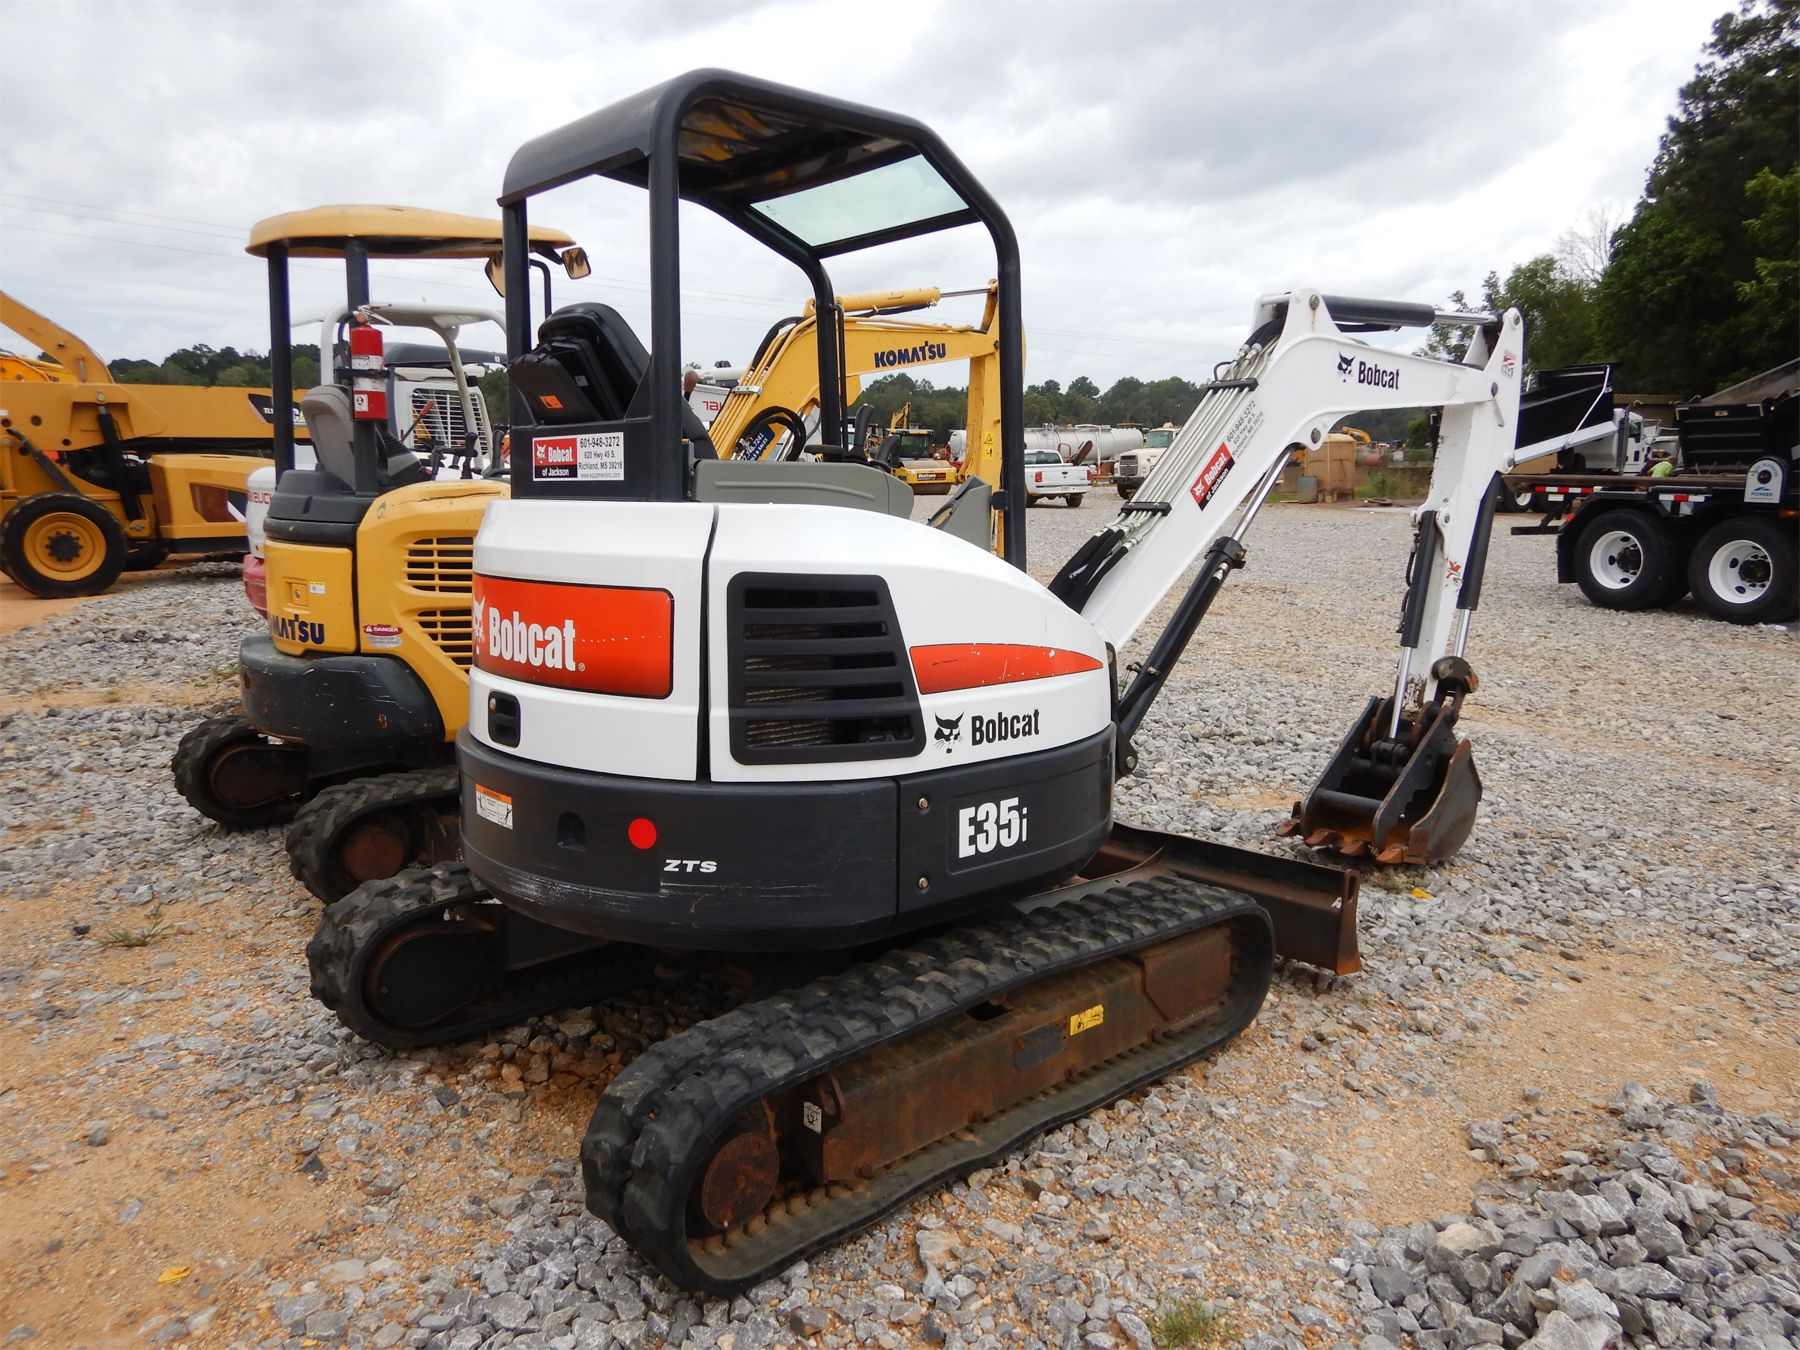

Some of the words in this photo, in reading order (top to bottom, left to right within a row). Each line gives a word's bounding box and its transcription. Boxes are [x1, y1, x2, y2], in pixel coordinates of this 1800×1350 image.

[874, 341, 946, 368] KOMATSU
[1358, 361, 1399, 390] Bobcat
[547, 446, 573, 463] Bobcat
[580, 436, 620, 448] 601-948-3272
[542, 468, 548, 476] of
[548, 467, 569, 476] Jackson
[600, 462, 608, 470] MS
[1204, 452, 1227, 485] Bobcat
[1211, 468, 1229, 493] Jackson
[272, 613, 325, 645] MATSU
[488, 607, 576, 671] Bobcat
[971, 708, 1040, 746] Bobcat
[959, 797, 1028, 858] E35i
[663, 859, 718, 873] ZTS
